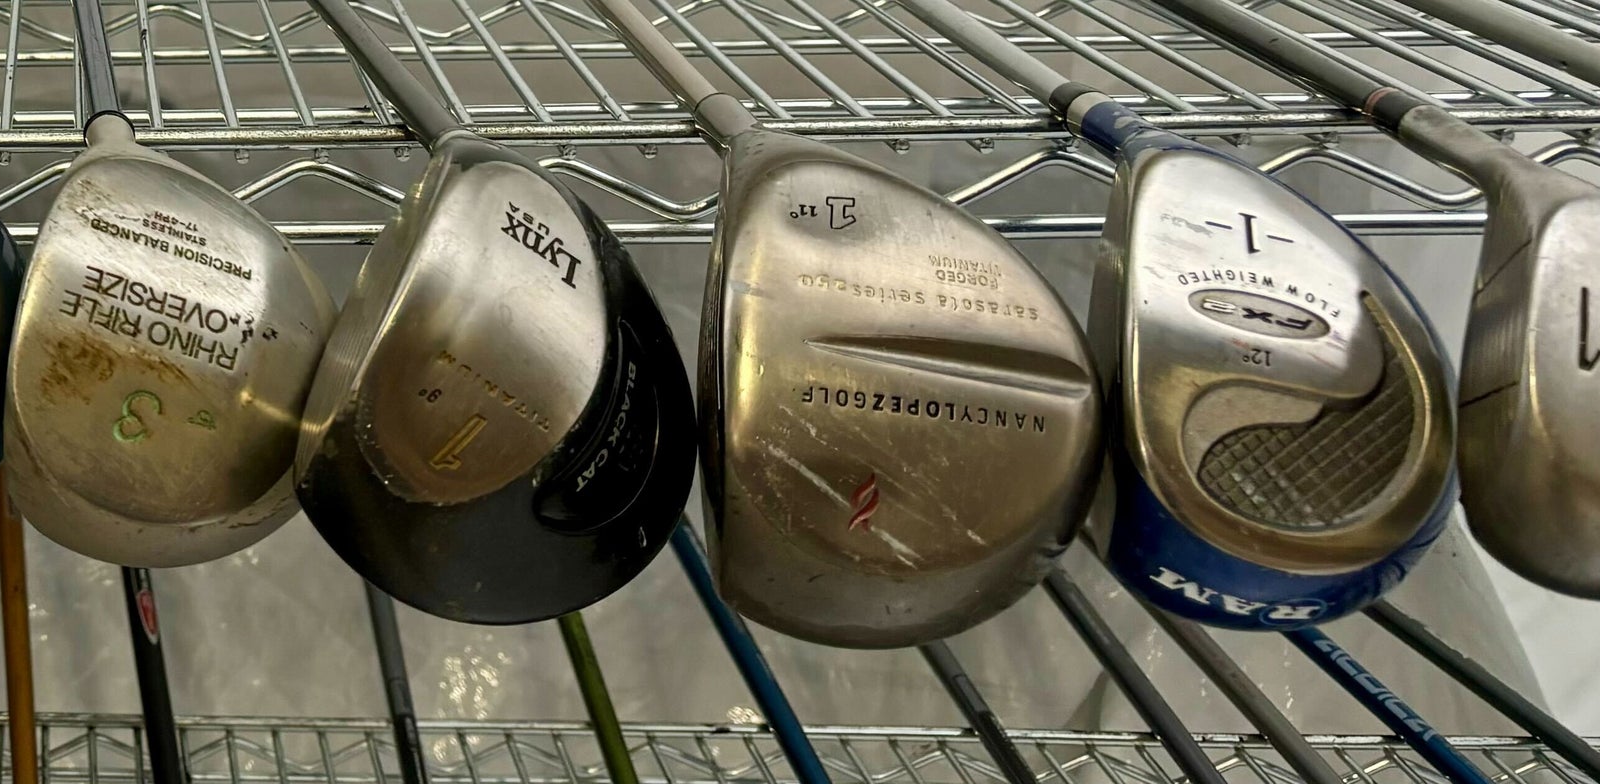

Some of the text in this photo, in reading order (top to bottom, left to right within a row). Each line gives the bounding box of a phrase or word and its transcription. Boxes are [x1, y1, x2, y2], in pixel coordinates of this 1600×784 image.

[142, 218, 207, 247] STAINLESS
[507, 200, 550, 236] USA
[826, 196, 856, 229] 1
[173, 245, 252, 281] PRECISION
[500, 211, 582, 289] Lynx
[927, 254, 1003, 277] TITANIUM
[82, 265, 229, 334] OVERSIZE
[935, 269, 999, 290] FORGED
[1177, 269, 1342, 319] FLOW WEIGHTED
[59, 289, 239, 371] RHINO RIFLE
[936, 294, 1040, 321] sarasota
[113, 390, 163, 443] 3
[437, 350, 550, 433] TITANIUM
[429, 413, 488, 470] 1
[575, 360, 636, 492] BLACK CAT
[1150, 566, 1322, 620] RAM
